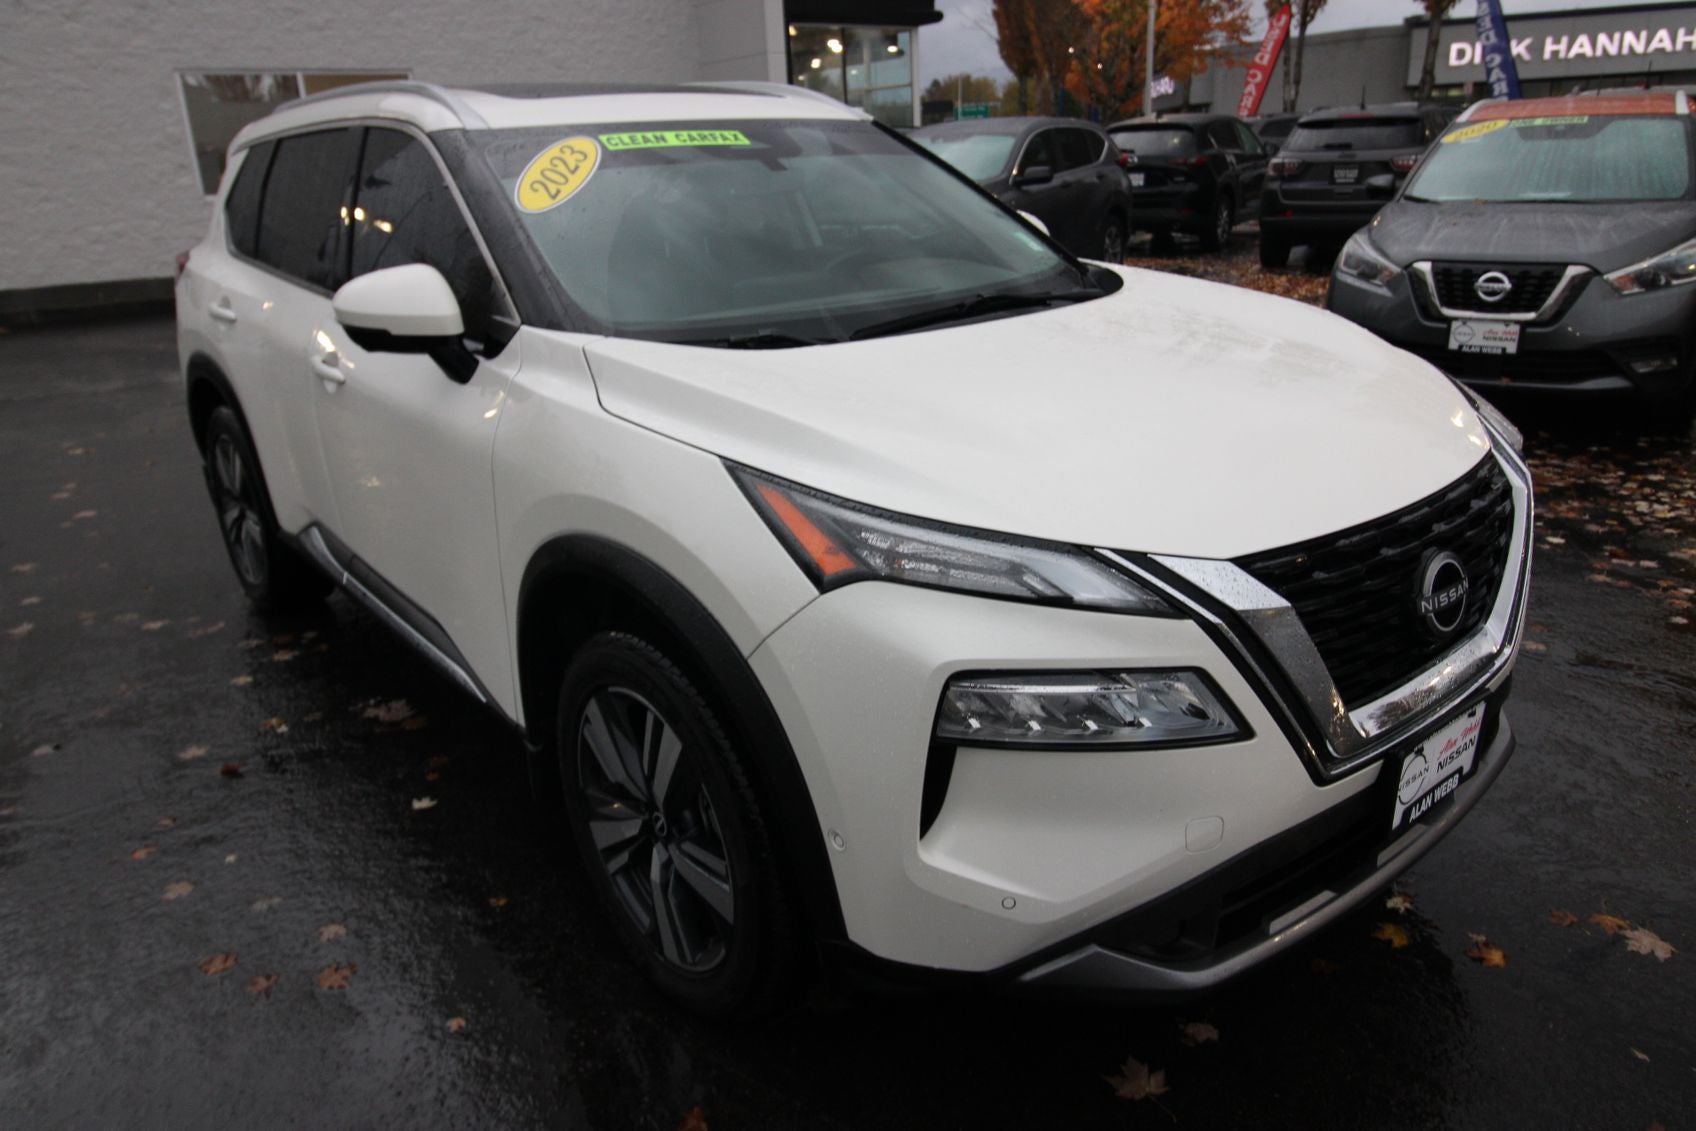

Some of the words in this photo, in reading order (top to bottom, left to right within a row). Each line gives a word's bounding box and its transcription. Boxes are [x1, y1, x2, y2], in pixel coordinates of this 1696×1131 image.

[1449, 36, 1533, 67] DIK
[1543, 27, 1696, 61] HANNAH
[605, 133, 667, 148] CLEAN
[675, 131, 742, 144] CARFAX
[529, 144, 588, 201] 2023
[1421, 576, 1469, 613] NISSAN
[1436, 736, 1477, 773] NISSAN
[1409, 793, 1433, 824] ALAN
[1434, 773, 1460, 803] WEBB
